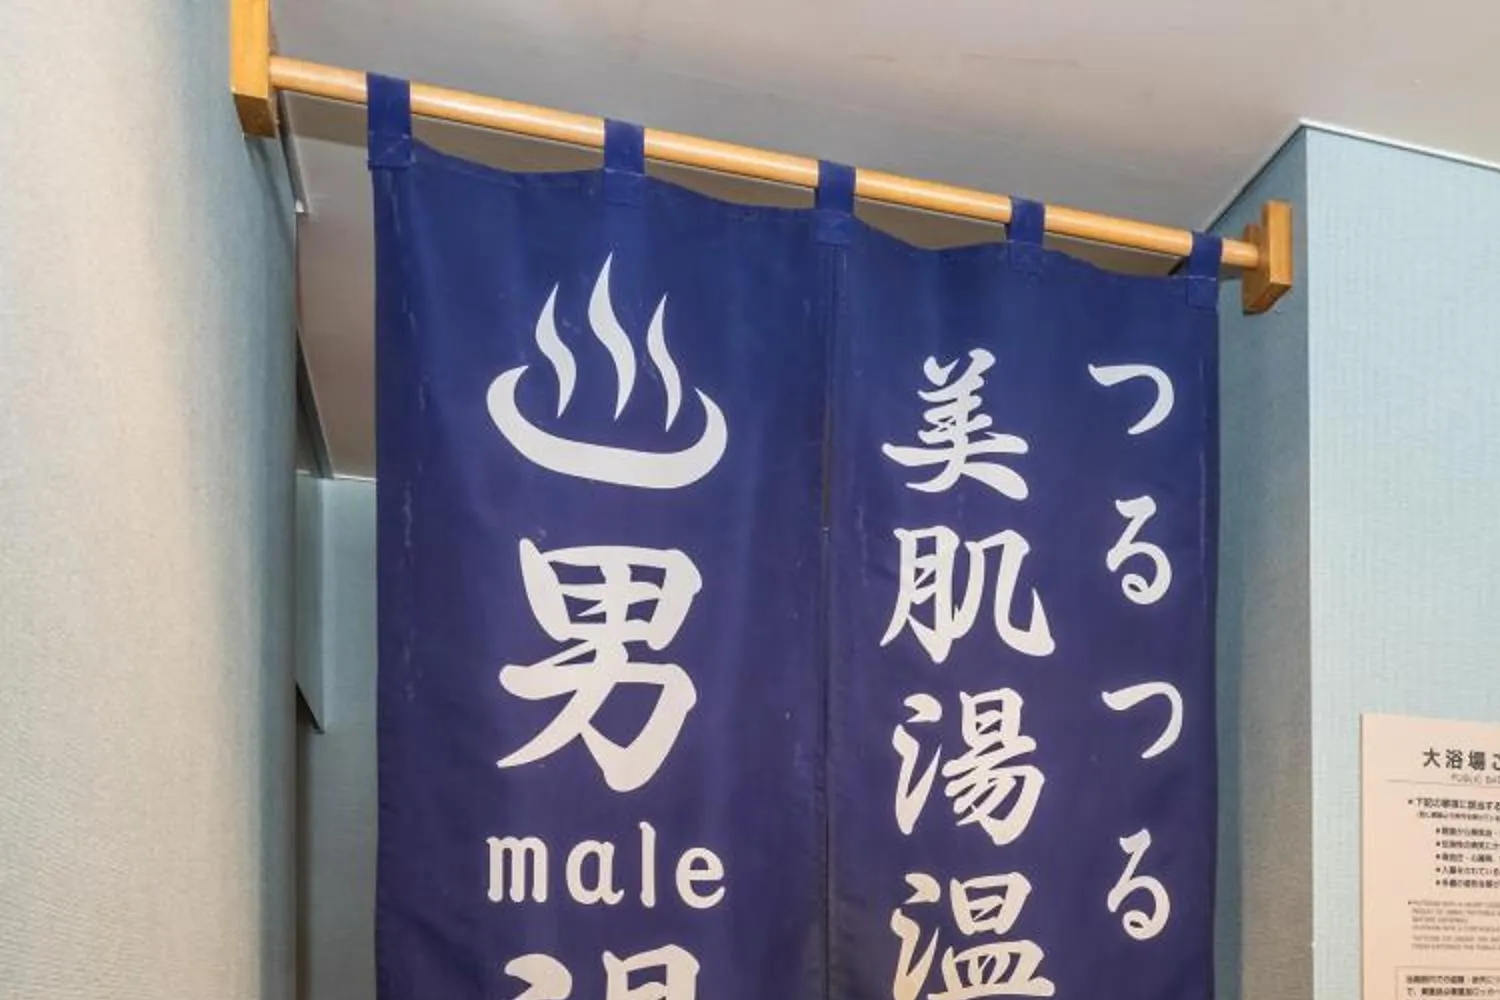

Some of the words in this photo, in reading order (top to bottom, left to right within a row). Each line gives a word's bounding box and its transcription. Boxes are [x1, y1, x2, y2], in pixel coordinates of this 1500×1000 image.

[1088, 361, 1183, 941] つるつる
[486, 821, 727, 909] male
